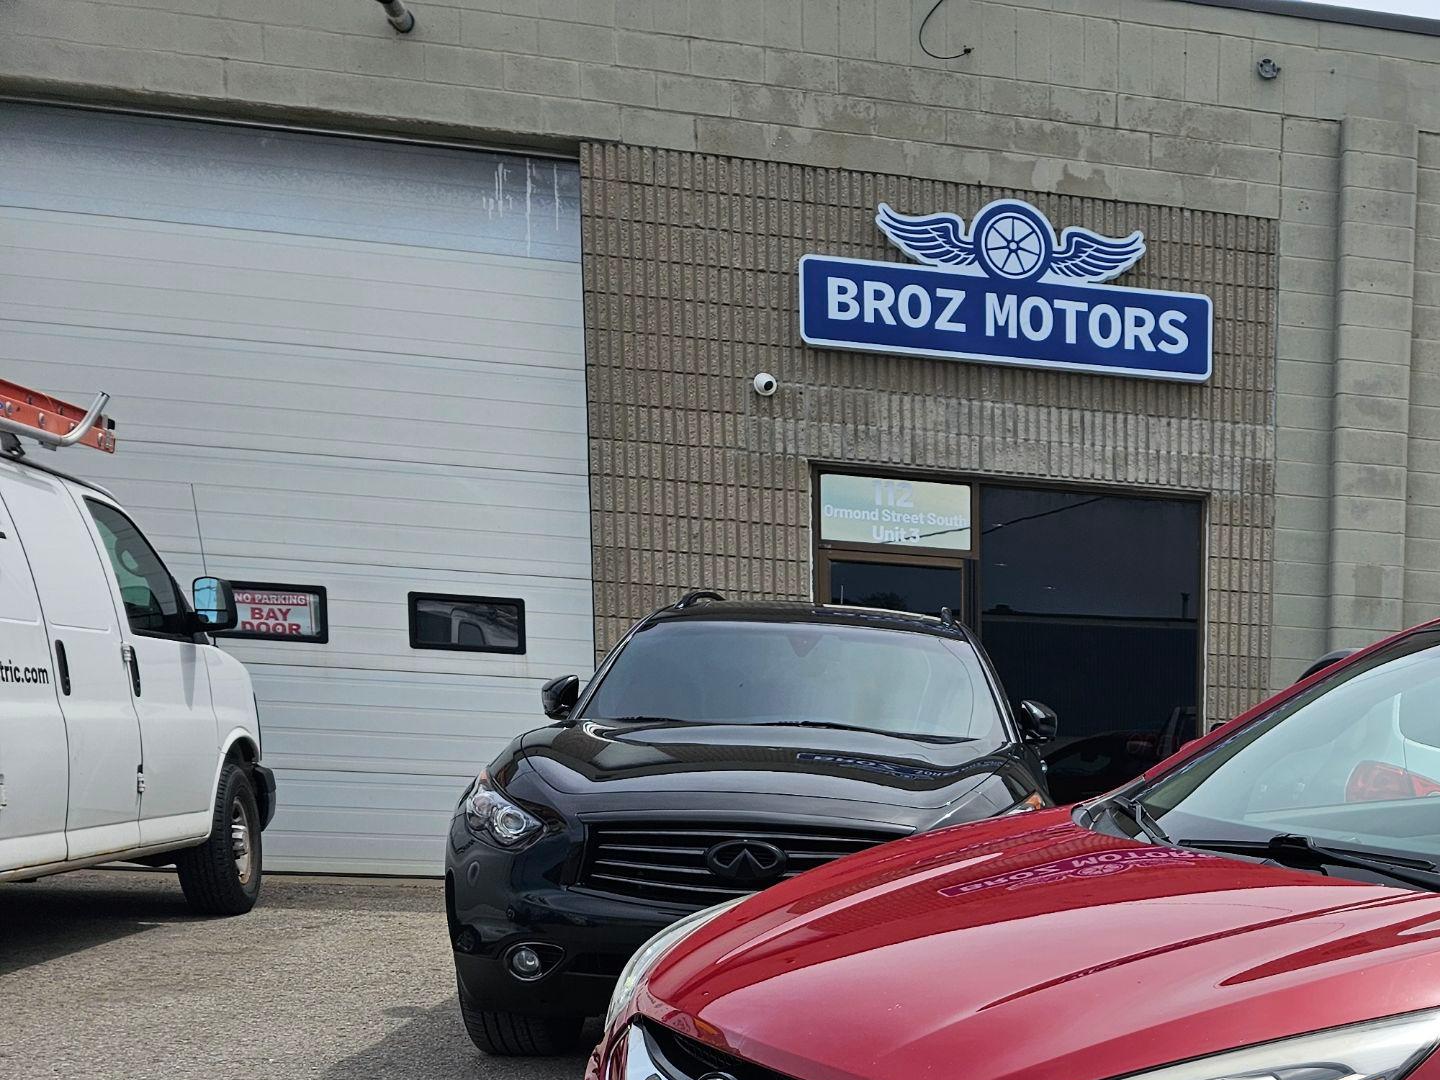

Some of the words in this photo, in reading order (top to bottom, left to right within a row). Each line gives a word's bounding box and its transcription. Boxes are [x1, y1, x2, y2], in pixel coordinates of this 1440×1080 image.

[827, 276, 967, 333] BROZ
[985, 291, 1190, 355] MOTORS
[873, 480, 914, 508] 112
[824, 504, 879, 521] Ormond
[882, 509, 925, 525] Street
[927, 513, 970, 528] South
[872, 525, 906, 542] Unit
[909, 529, 920, 543] 3
[234, 593, 251, 602] NO
[254, 594, 307, 605] PARKING
[250, 607, 291, 621] BAY
[241, 621, 302, 636] DOOR
